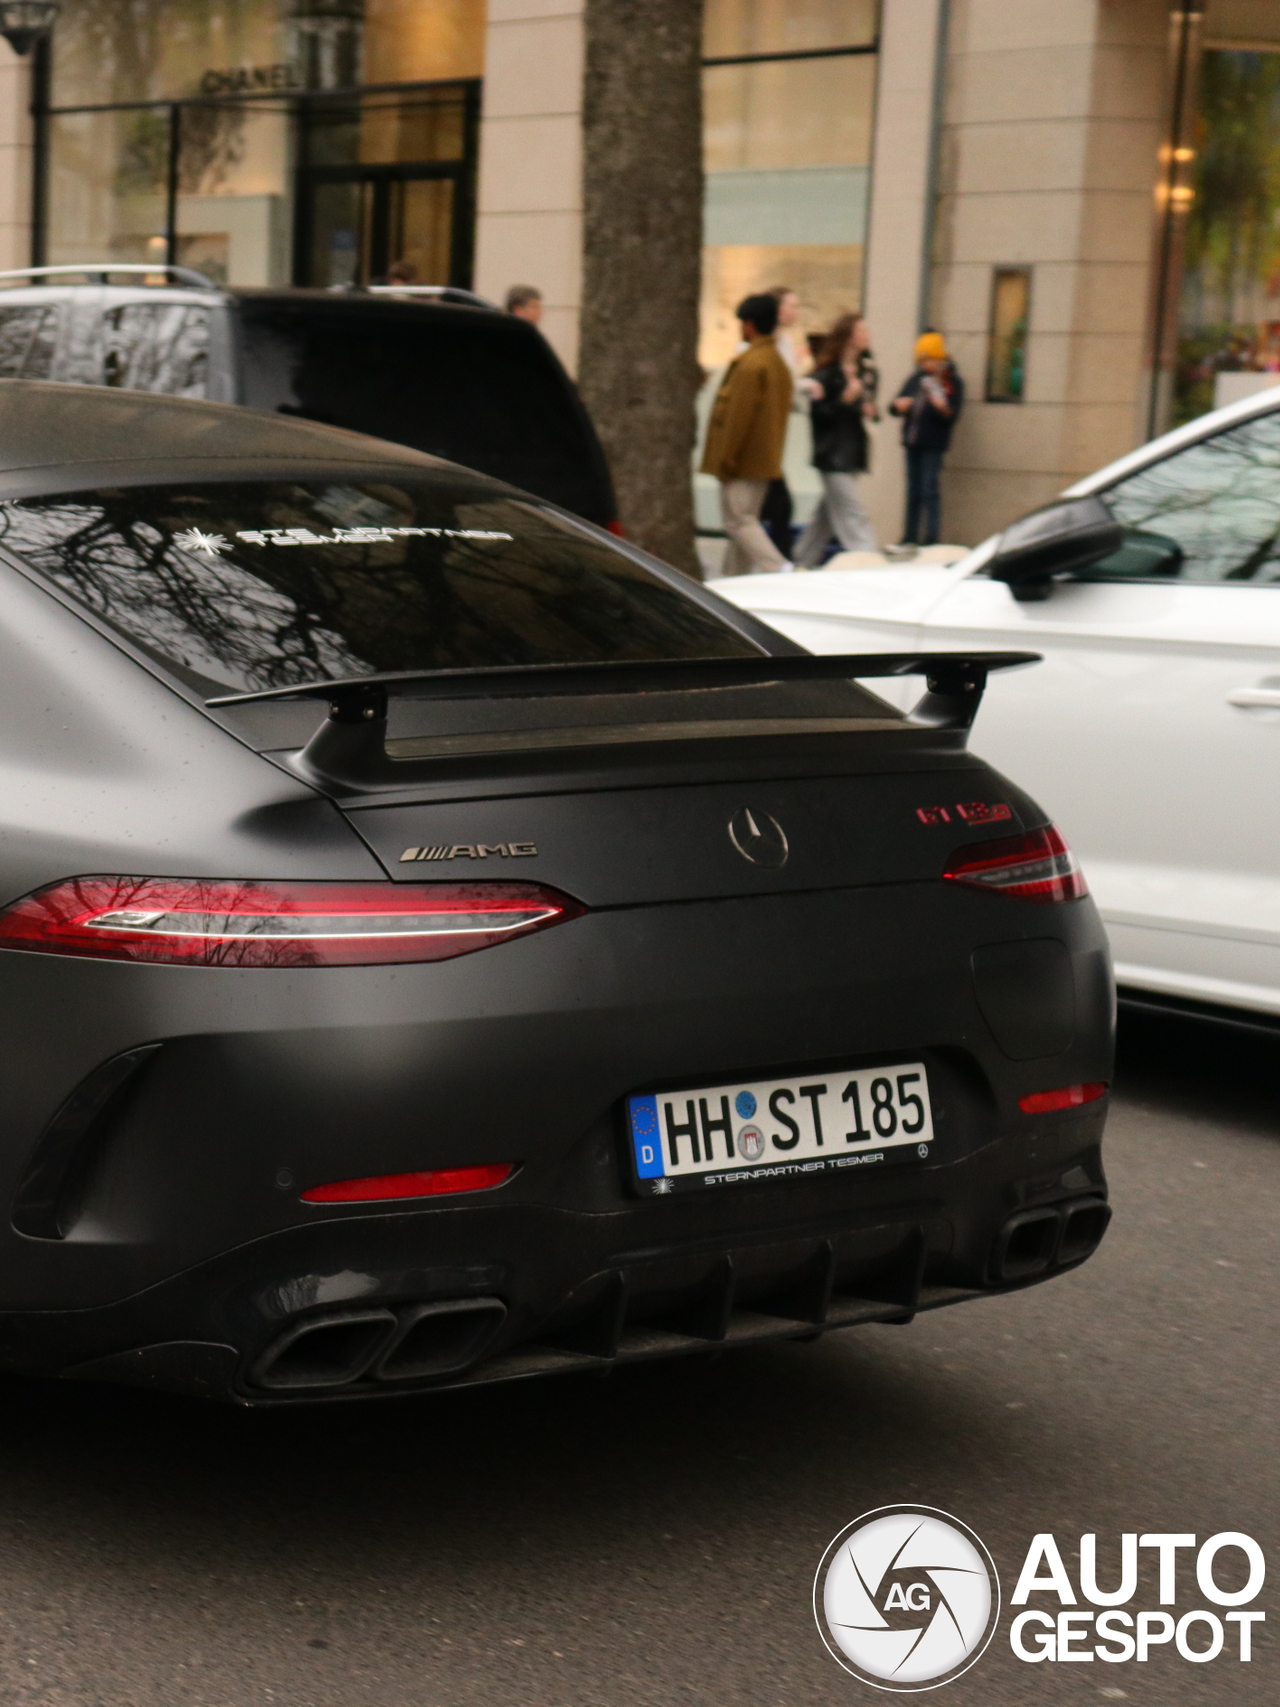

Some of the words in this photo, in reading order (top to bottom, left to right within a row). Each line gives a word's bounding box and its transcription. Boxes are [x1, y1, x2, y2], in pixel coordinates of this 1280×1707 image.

[201, 63, 301, 93] CHANEL
[446, 841, 538, 860] AMG
[664, 1095, 735, 1166] HH
[768, 1083, 828, 1151] ST
[841, 1072, 926, 1144] 185
[641, 1145, 655, 1165] D
[704, 1161, 826, 1185] STERNPARTNER
[827, 1152, 885, 1169] TESMER
